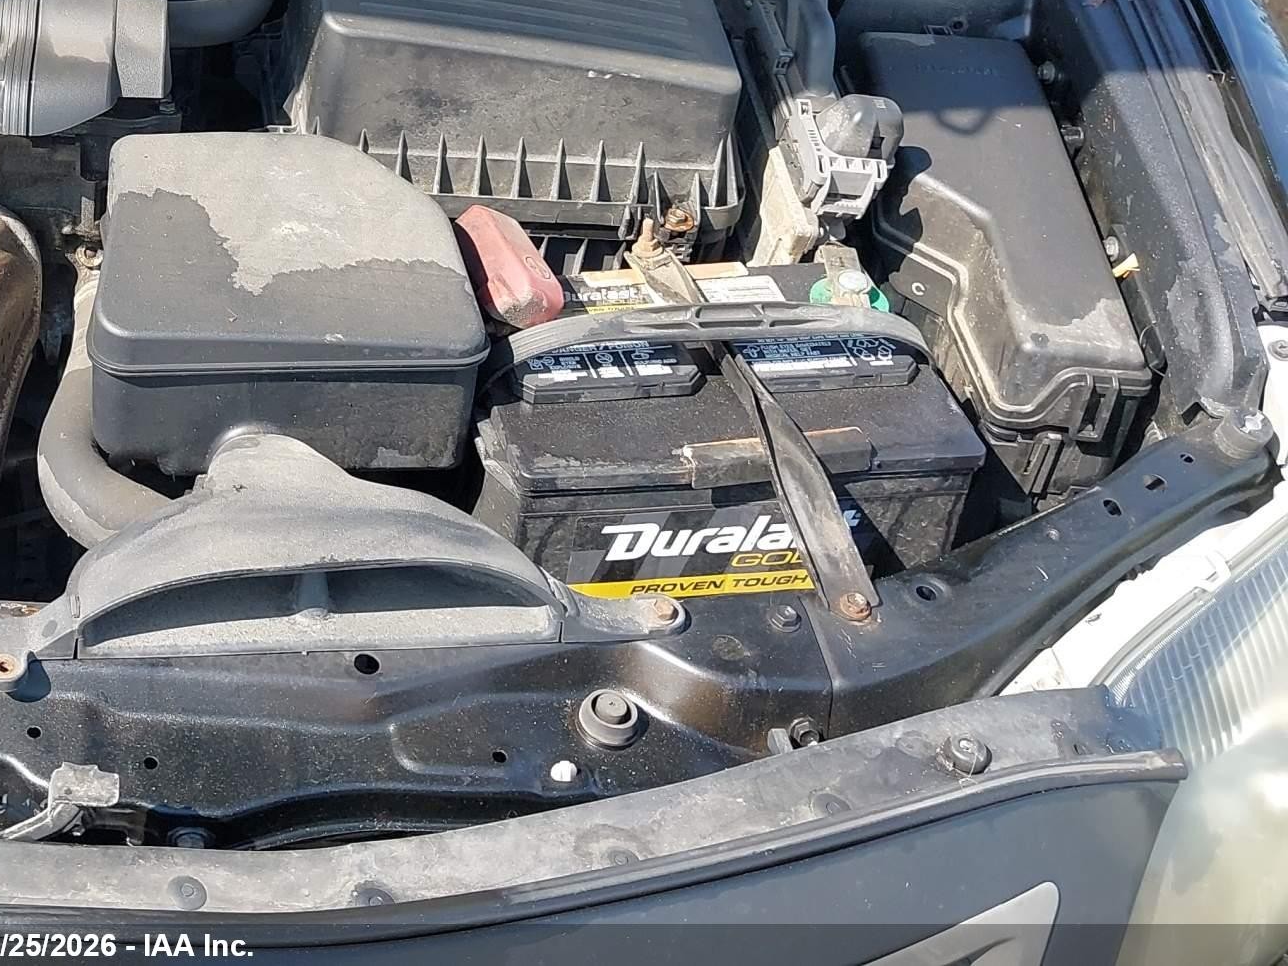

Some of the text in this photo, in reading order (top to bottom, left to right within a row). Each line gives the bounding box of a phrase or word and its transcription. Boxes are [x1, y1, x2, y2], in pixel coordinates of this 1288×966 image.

[600, 509, 861, 562] Durala
[730, 550, 804, 568] GOL
[629, 573, 810, 595] PROVEN TOUGH
